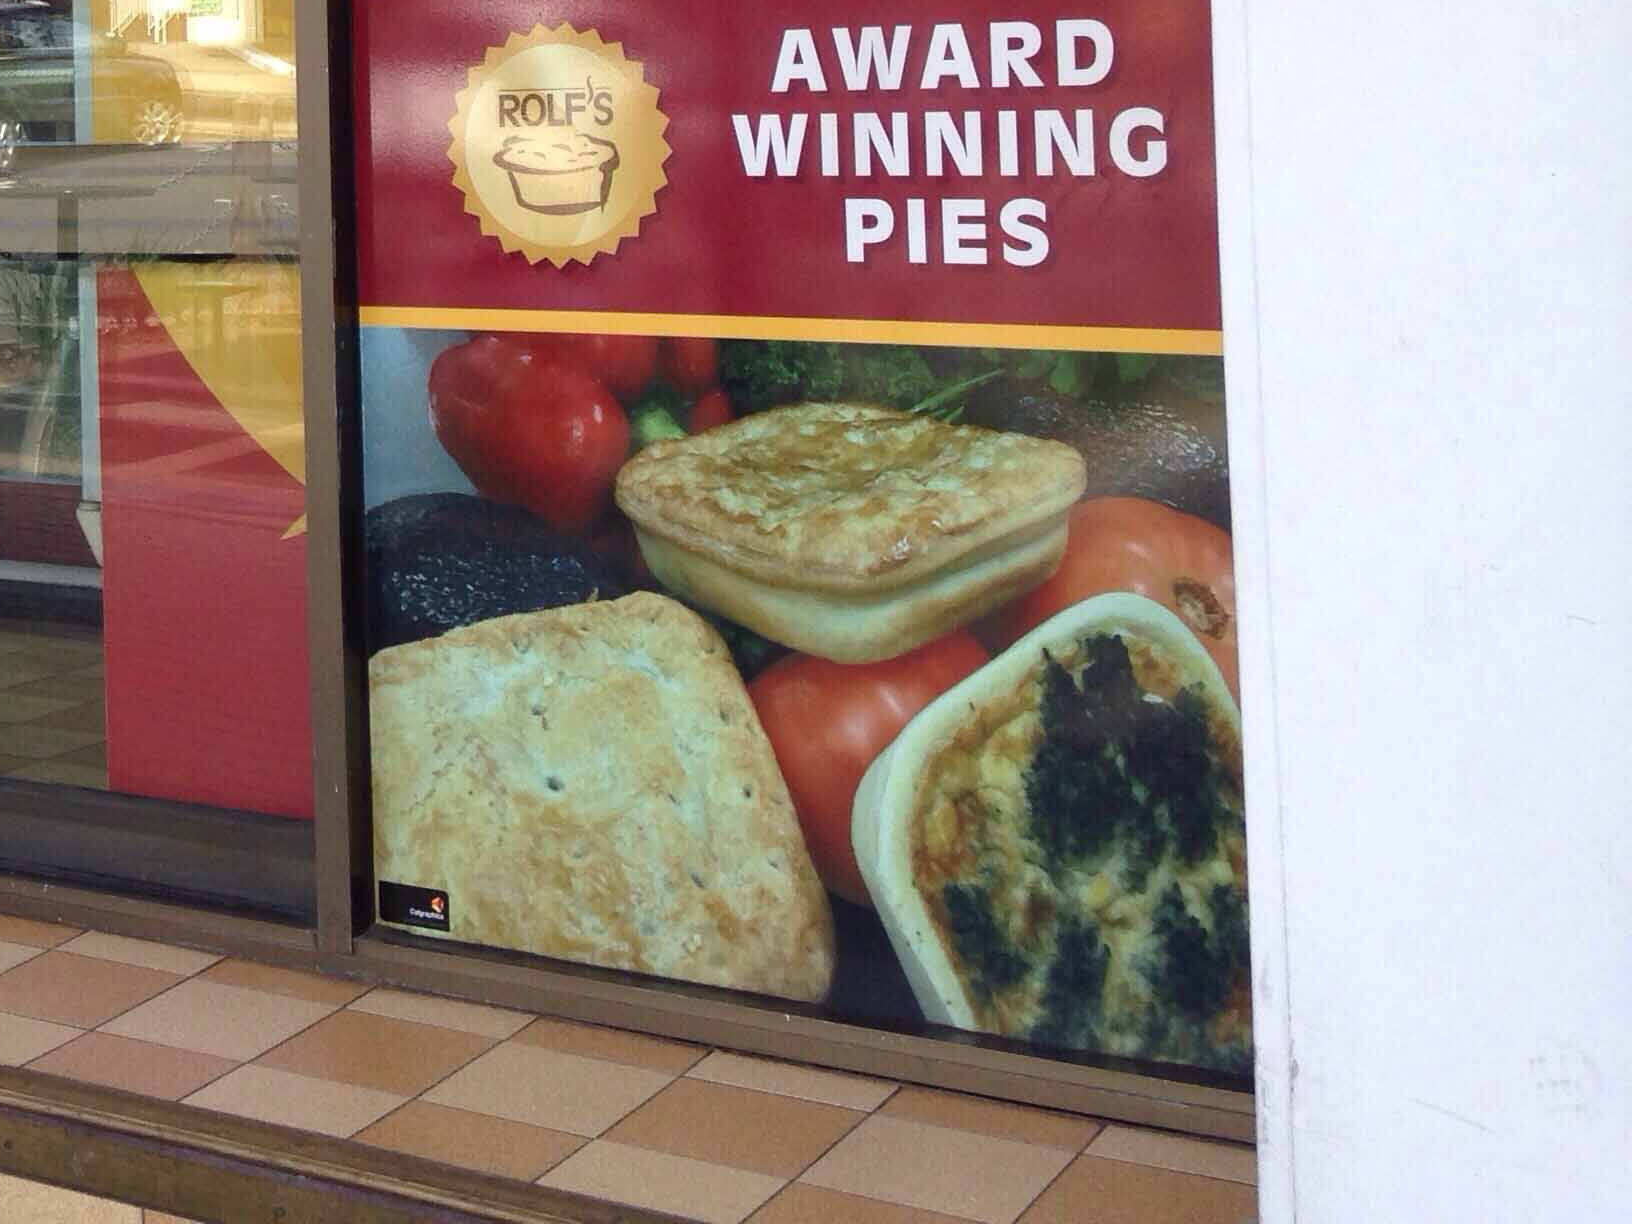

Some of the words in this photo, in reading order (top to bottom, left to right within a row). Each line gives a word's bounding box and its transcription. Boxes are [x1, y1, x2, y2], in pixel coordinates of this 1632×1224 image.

[770, 17, 1116, 94] AWARD
[497, 80, 614, 129] ROLF'S
[732, 107, 1168, 178] WINNING
[844, 197, 1051, 267] PIES
